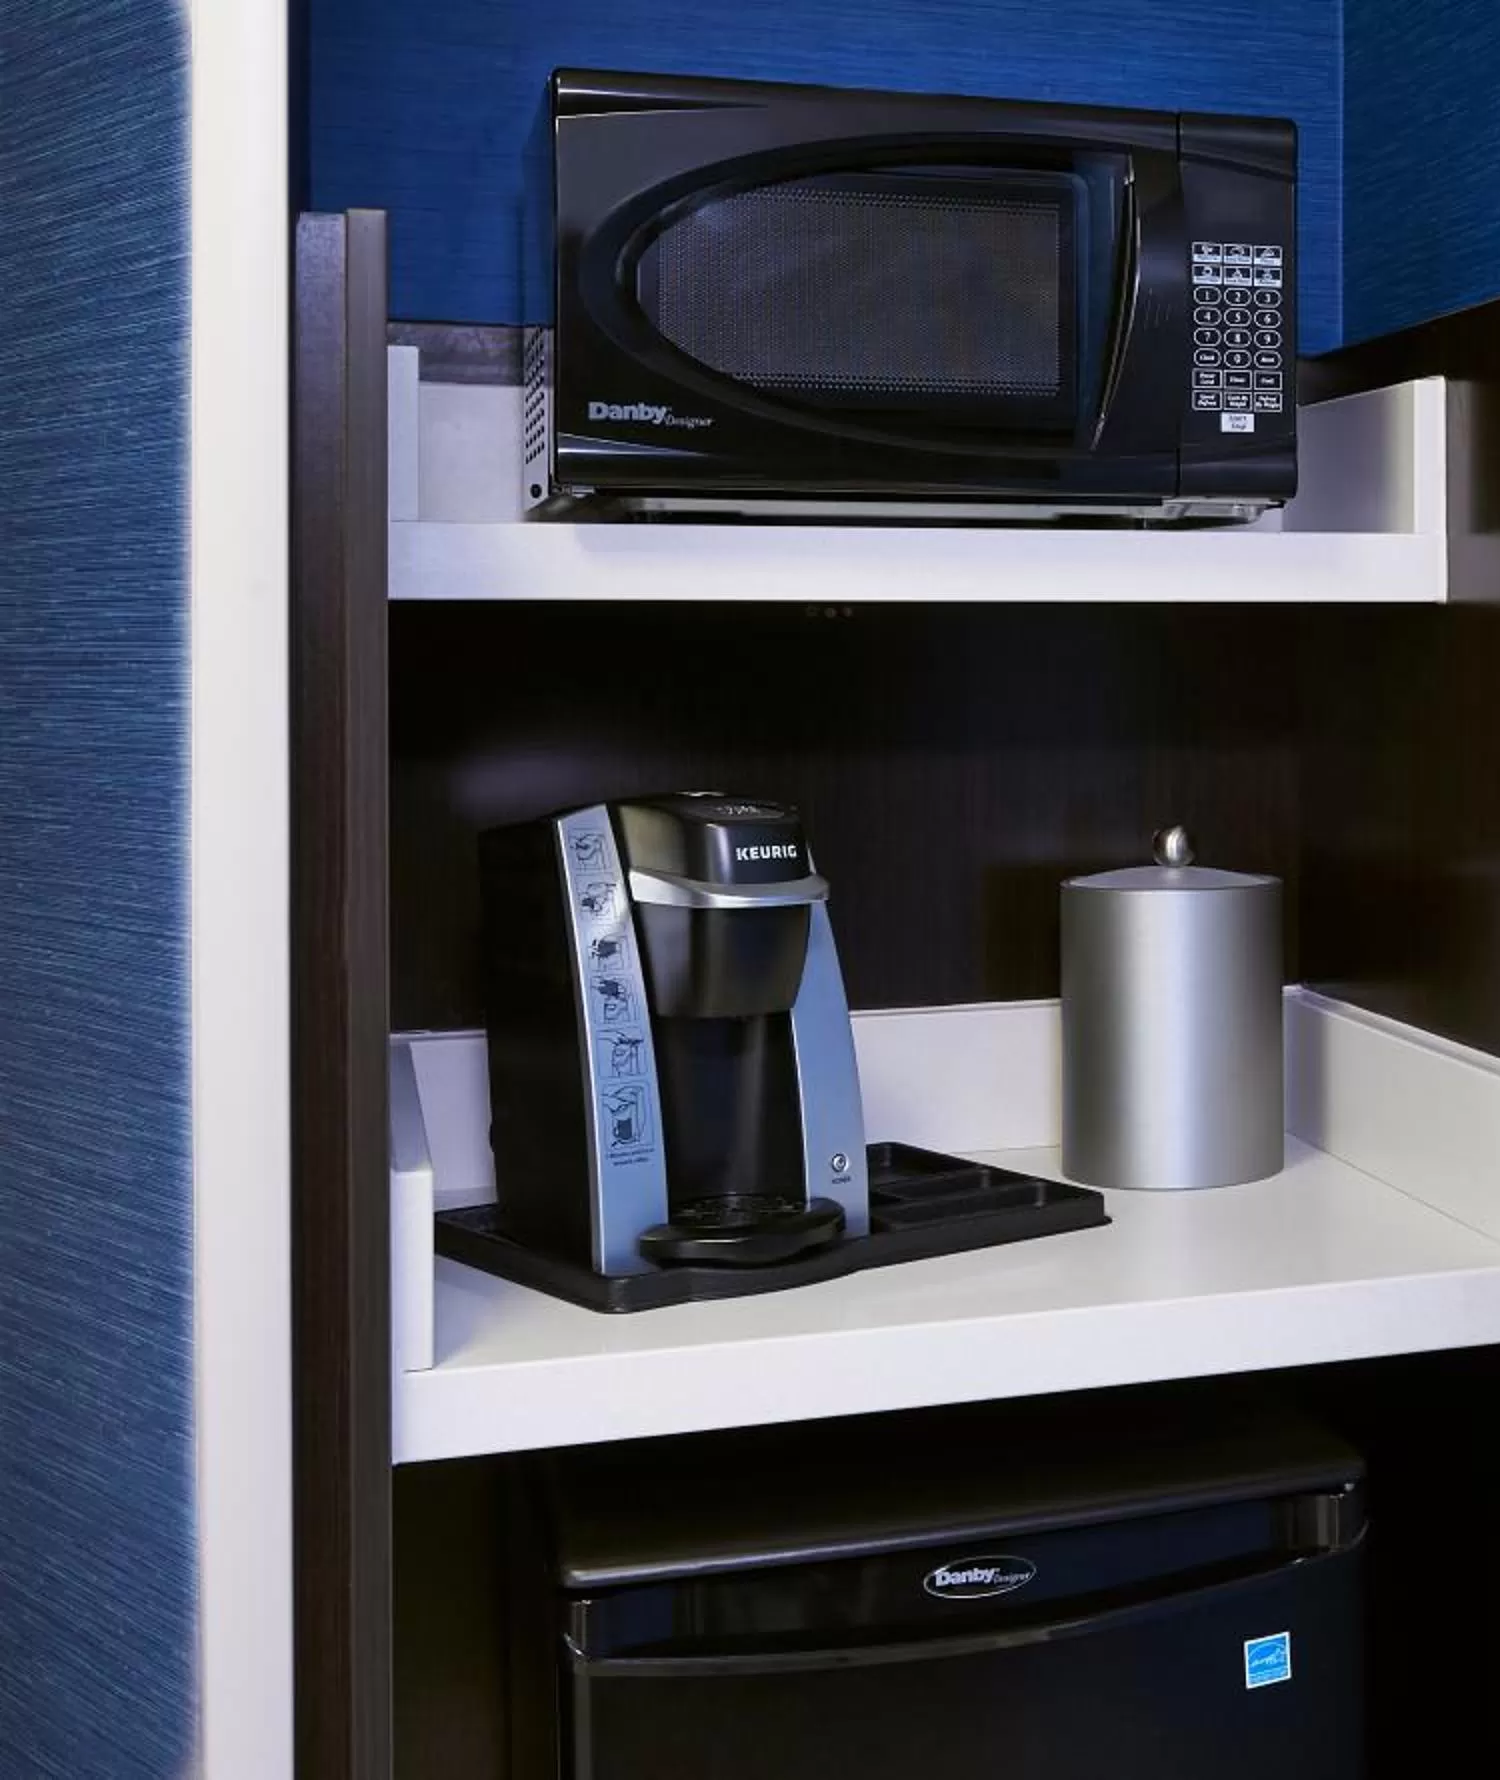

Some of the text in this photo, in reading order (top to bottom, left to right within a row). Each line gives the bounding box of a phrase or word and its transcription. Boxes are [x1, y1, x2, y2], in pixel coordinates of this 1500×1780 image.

[1204, 290, 1211, 301] 1
[1234, 291, 1241, 303] 2
[1203, 311, 1211, 321] 4
[1234, 311, 1241, 323] 5
[1263, 313, 1271, 324] 6
[1203, 331, 1211, 342] 7
[1263, 333, 1271, 344] 9
[588, 401, 666, 425] Danby
[735, 844, 798, 861] KEURIG
[934, 1567, 996, 1587] Danby
